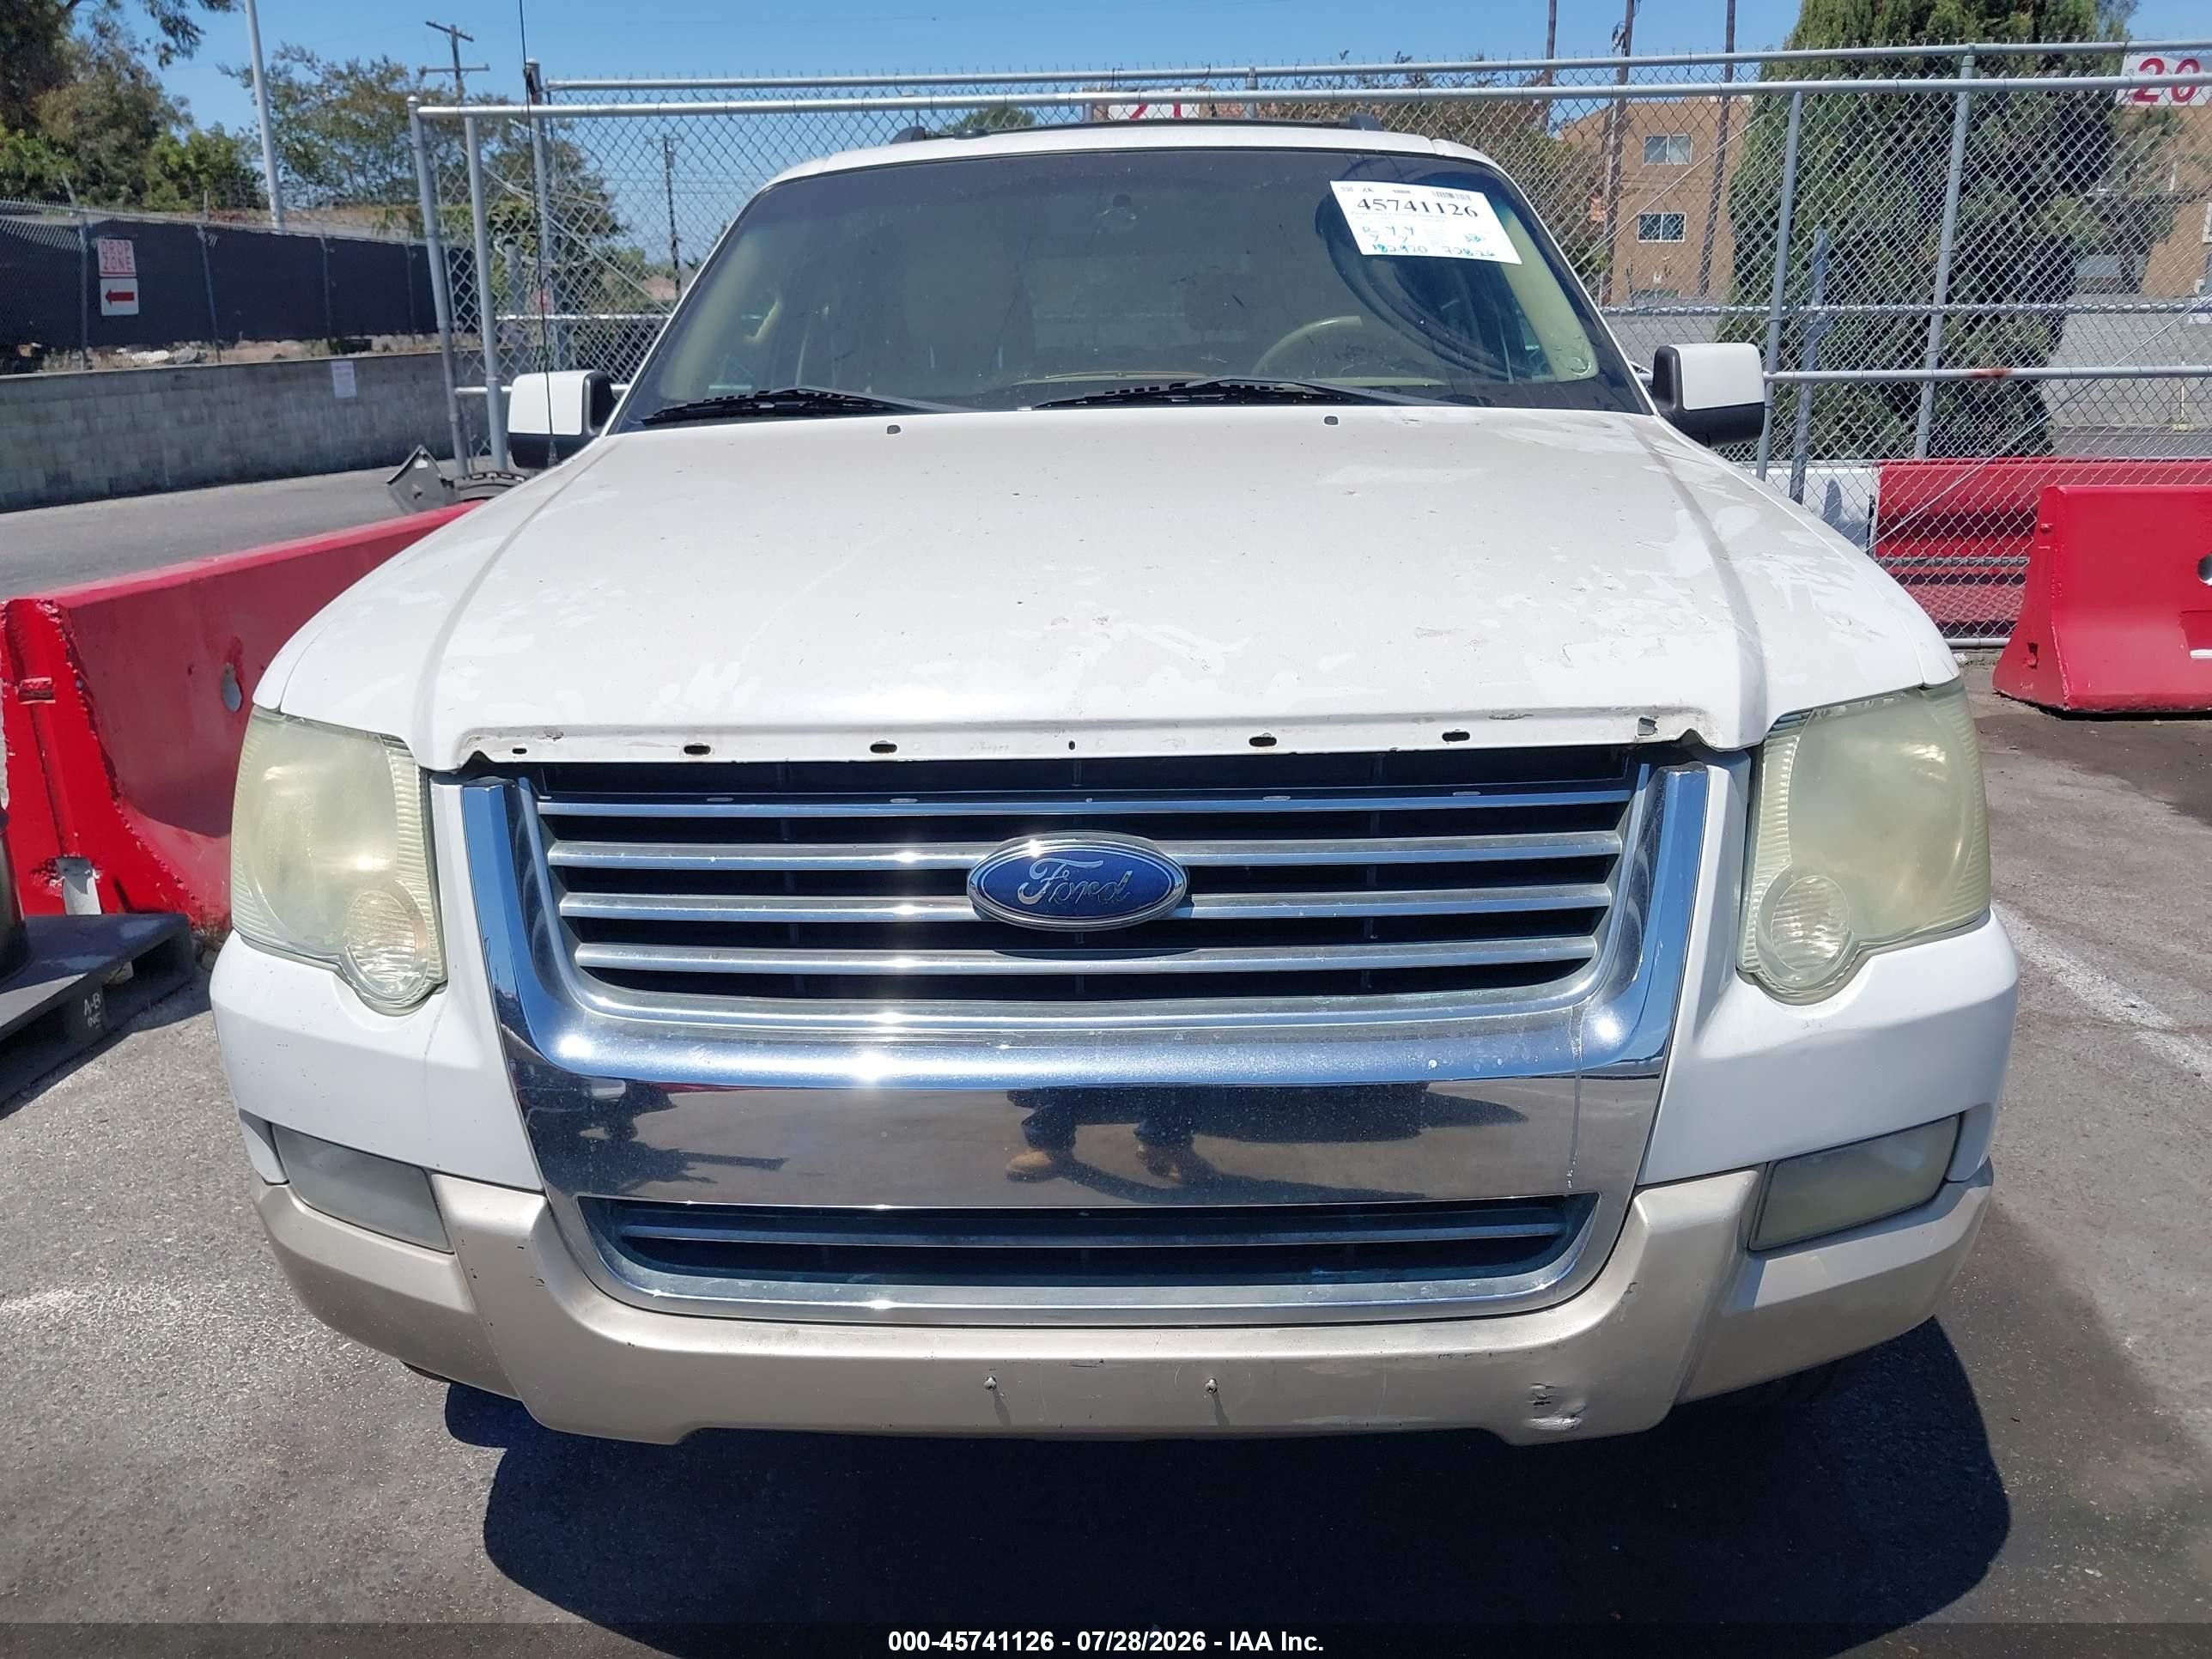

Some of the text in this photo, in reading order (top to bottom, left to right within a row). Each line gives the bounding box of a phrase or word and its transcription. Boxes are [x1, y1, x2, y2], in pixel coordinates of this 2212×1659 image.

[2133, 58, 2200, 103] 20
[1358, 198, 1478, 217] 45741126
[102, 240, 131, 255] DROP
[104, 256, 133, 270] ZONE
[1017, 857, 1133, 905] Ford
